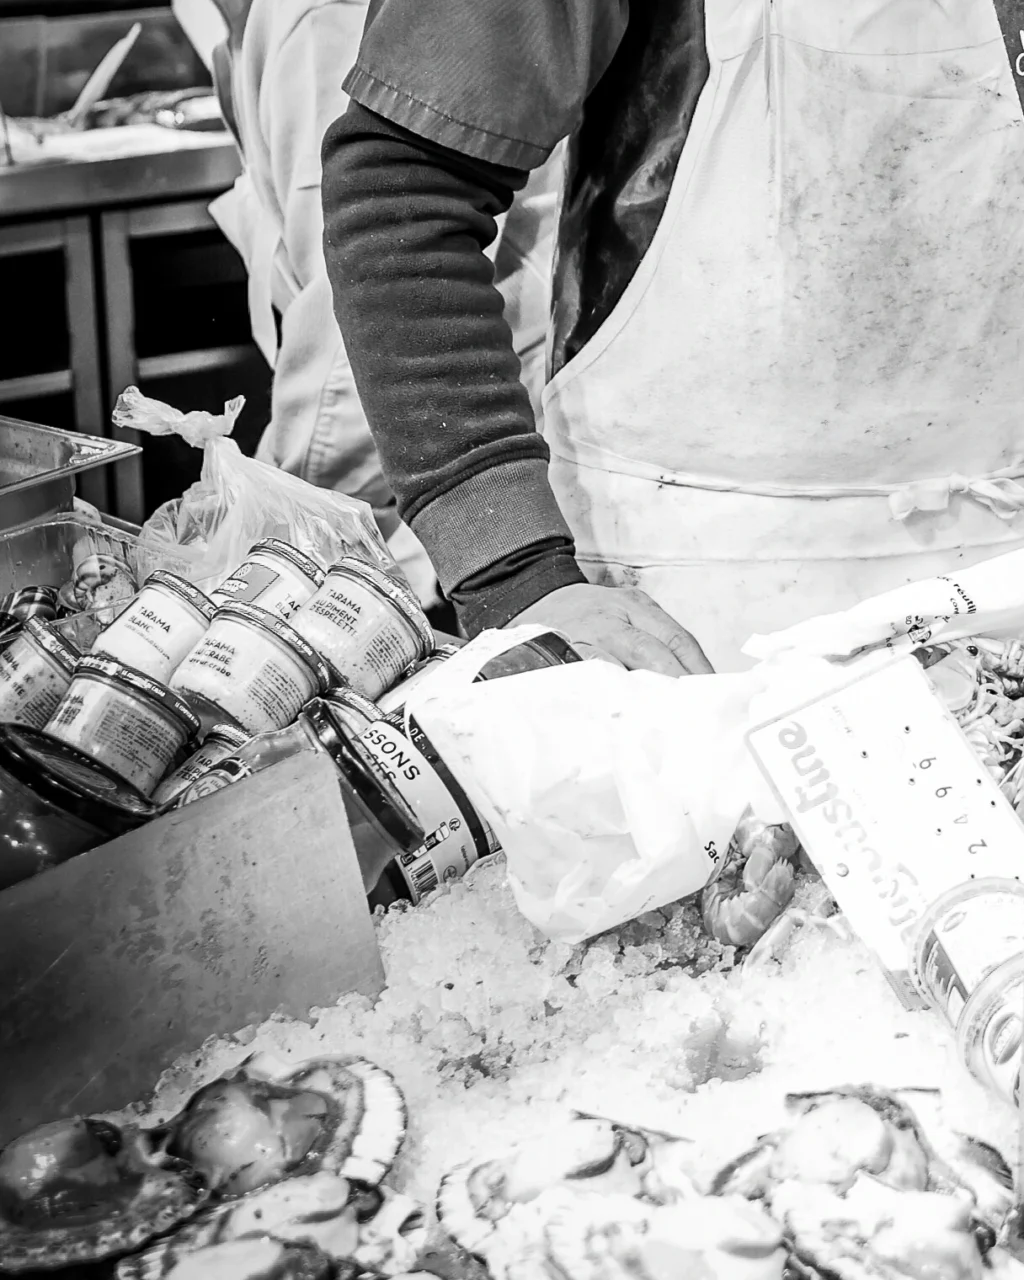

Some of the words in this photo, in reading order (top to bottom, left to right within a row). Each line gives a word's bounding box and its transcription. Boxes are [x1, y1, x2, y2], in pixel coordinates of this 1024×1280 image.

[138, 605, 172, 634] TARAMA
[327, 588, 363, 616] TARAMA
[362, 728, 420, 782] SSONS
[778, 721, 919, 942] ngoustine
